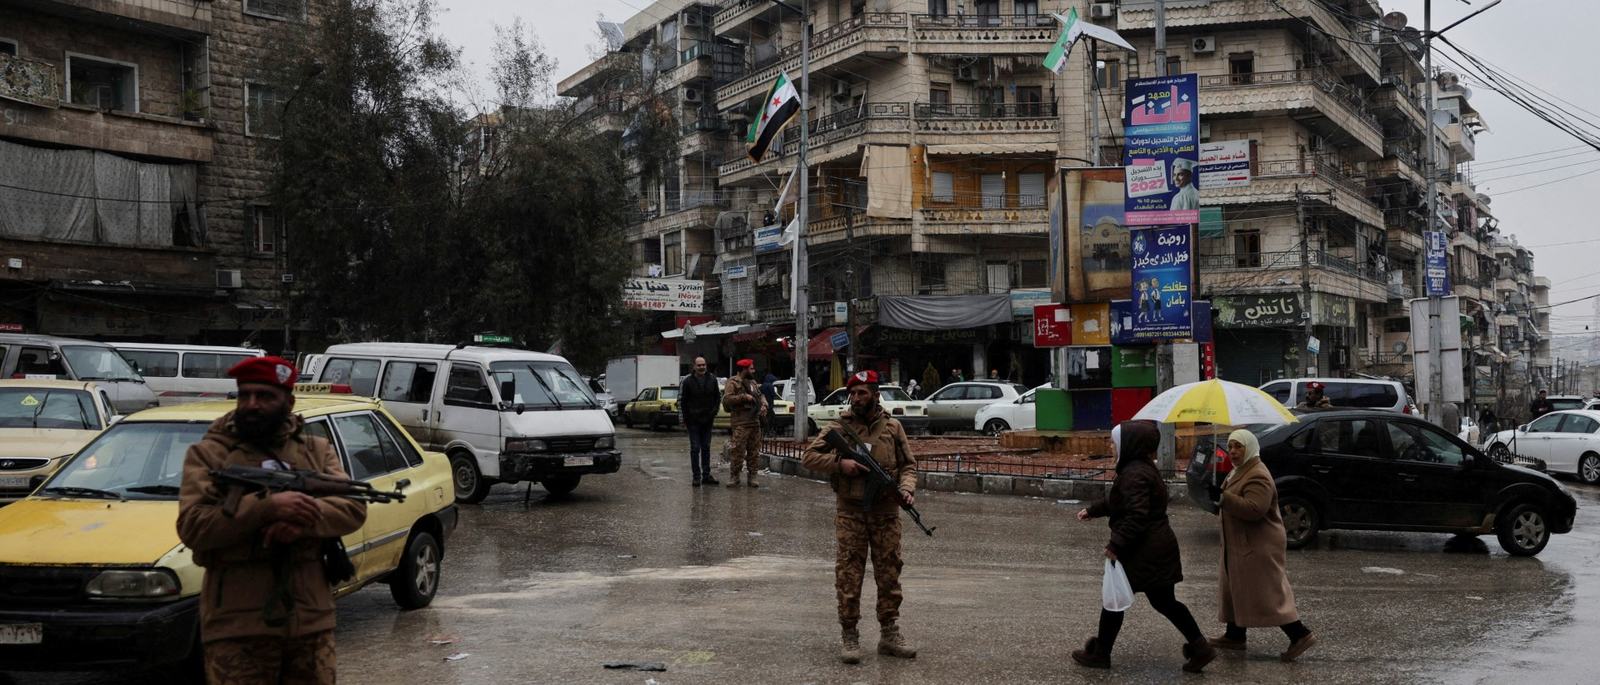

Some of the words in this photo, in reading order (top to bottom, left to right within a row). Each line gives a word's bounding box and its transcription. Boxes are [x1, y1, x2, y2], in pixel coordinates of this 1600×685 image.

[1147, 91, 1170, 100] معهد
[1131, 138, 1151, 146] لدورات
[1151, 136, 1174, 145] التسجيل
[1130, 178, 1165, 193] 2027
[1157, 233, 1186, 246] روضة
[1133, 252, 1150, 269] كيدز
[1173, 251, 1188, 266] قطر
[1161, 281, 1187, 292] طفلك
[1245, 297, 1294, 320] تاتش
